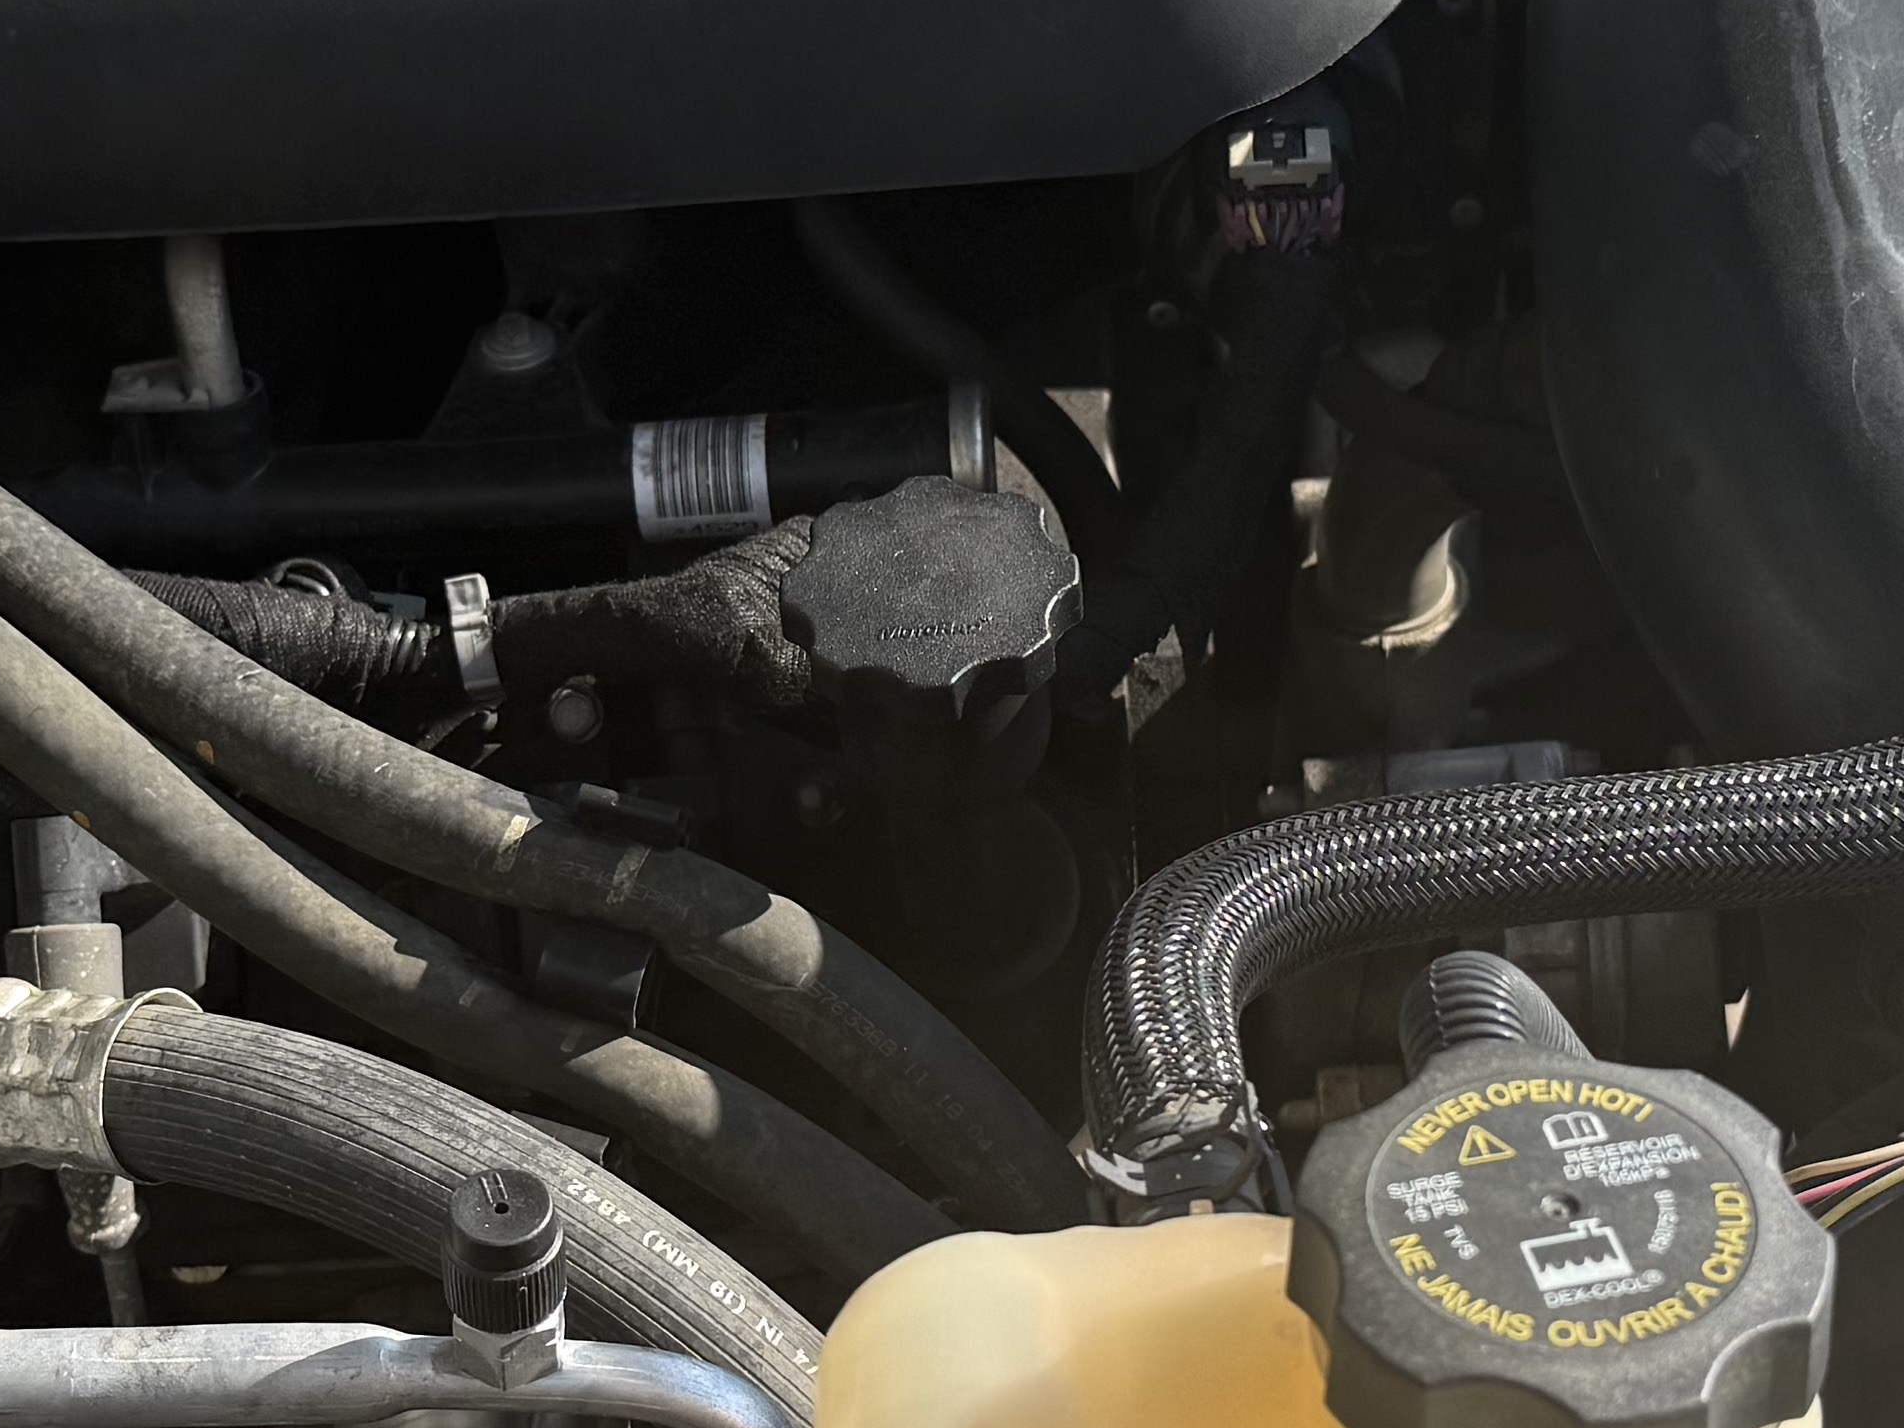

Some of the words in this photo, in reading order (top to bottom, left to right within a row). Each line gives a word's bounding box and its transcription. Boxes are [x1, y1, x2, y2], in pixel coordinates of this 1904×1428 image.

[1396, 1090, 1491, 1155] NEVER
[1485, 1079, 1575, 1109] OPEN
[1578, 1082, 1656, 1122] HOT!
[1387, 1171, 1464, 1200] SURGE
[642, 1229, 701, 1278] MM)
[1388, 1232, 1437, 1276] NE
[1416, 1272, 1536, 1342] JAMAIS
[1547, 1297, 1695, 1348] OUVRIR
[1701, 1182, 1752, 1284] CHAUD!
[755, 1315, 785, 1347] IN
